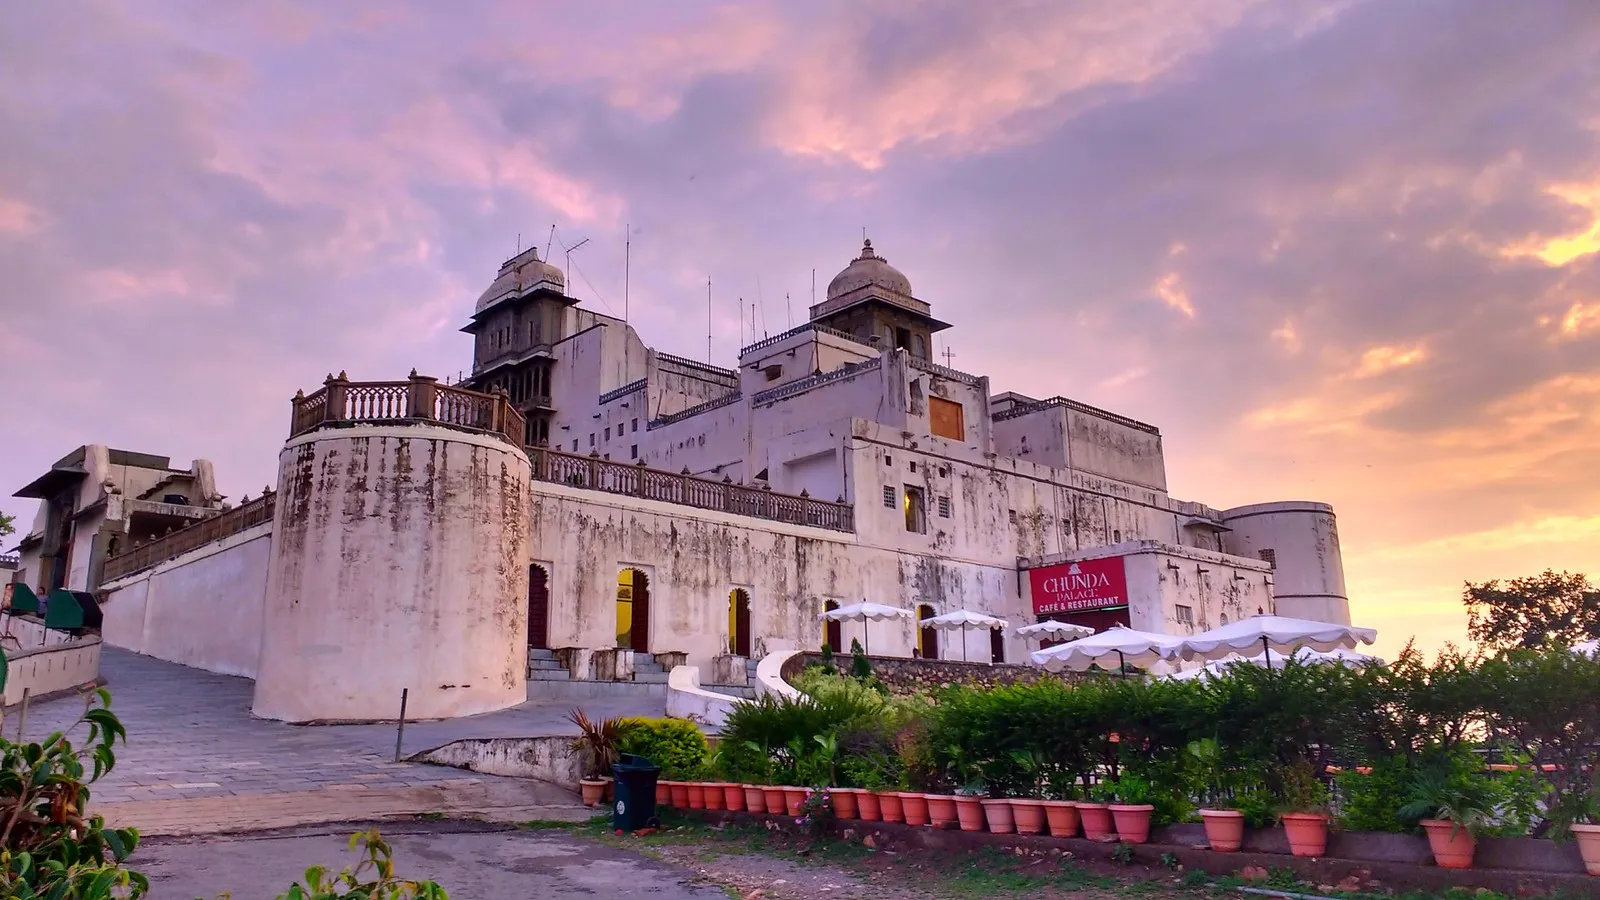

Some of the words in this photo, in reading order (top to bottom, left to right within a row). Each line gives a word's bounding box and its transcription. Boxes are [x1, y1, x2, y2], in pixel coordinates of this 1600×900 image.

[1043, 572, 1110, 593] CHUNDA
[1056, 588, 1099, 602] PALACE
[1061, 602, 1066, 610] &
[1067, 596, 1119, 609] RESTAURANT
